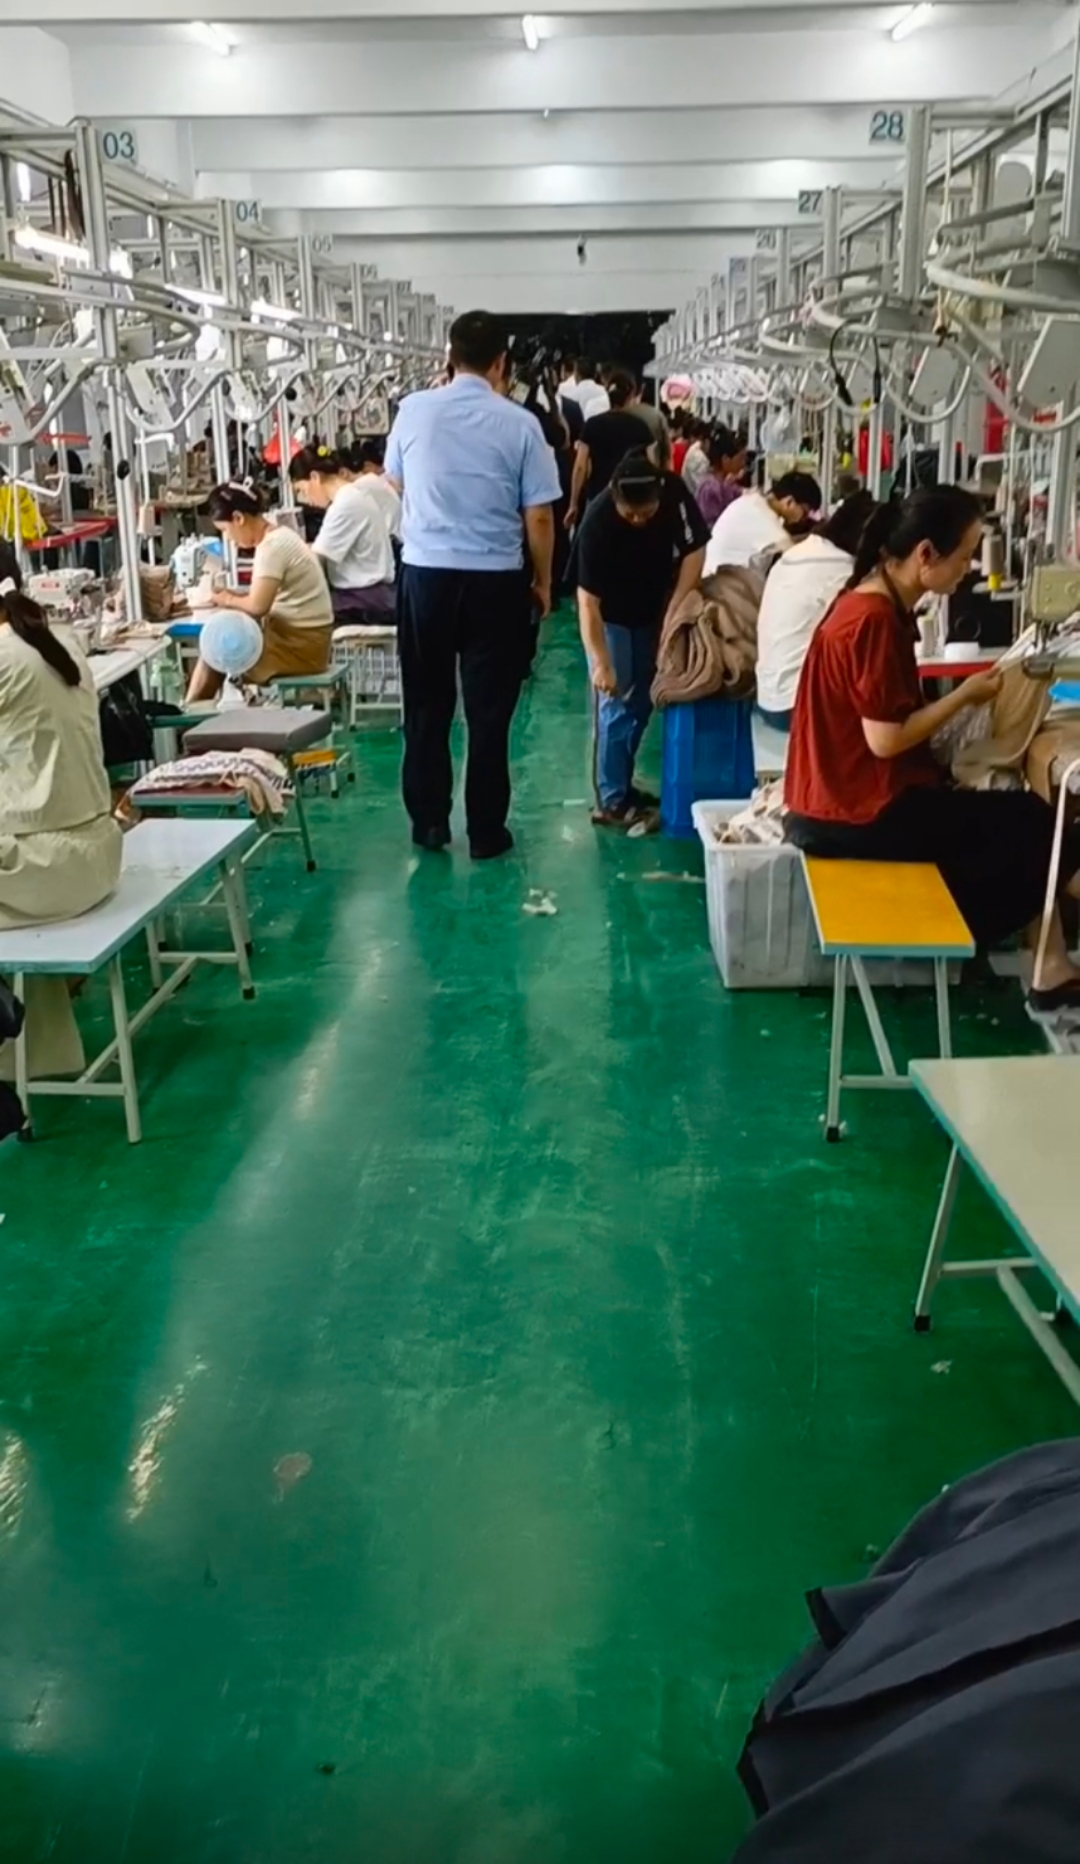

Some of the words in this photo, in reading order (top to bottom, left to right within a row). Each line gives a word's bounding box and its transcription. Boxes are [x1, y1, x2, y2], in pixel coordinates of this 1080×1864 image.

[872, 110, 904, 140] 28
[103, 131, 135, 160] 03
[236, 201, 259, 222] 04
[799, 189, 823, 213] 27
